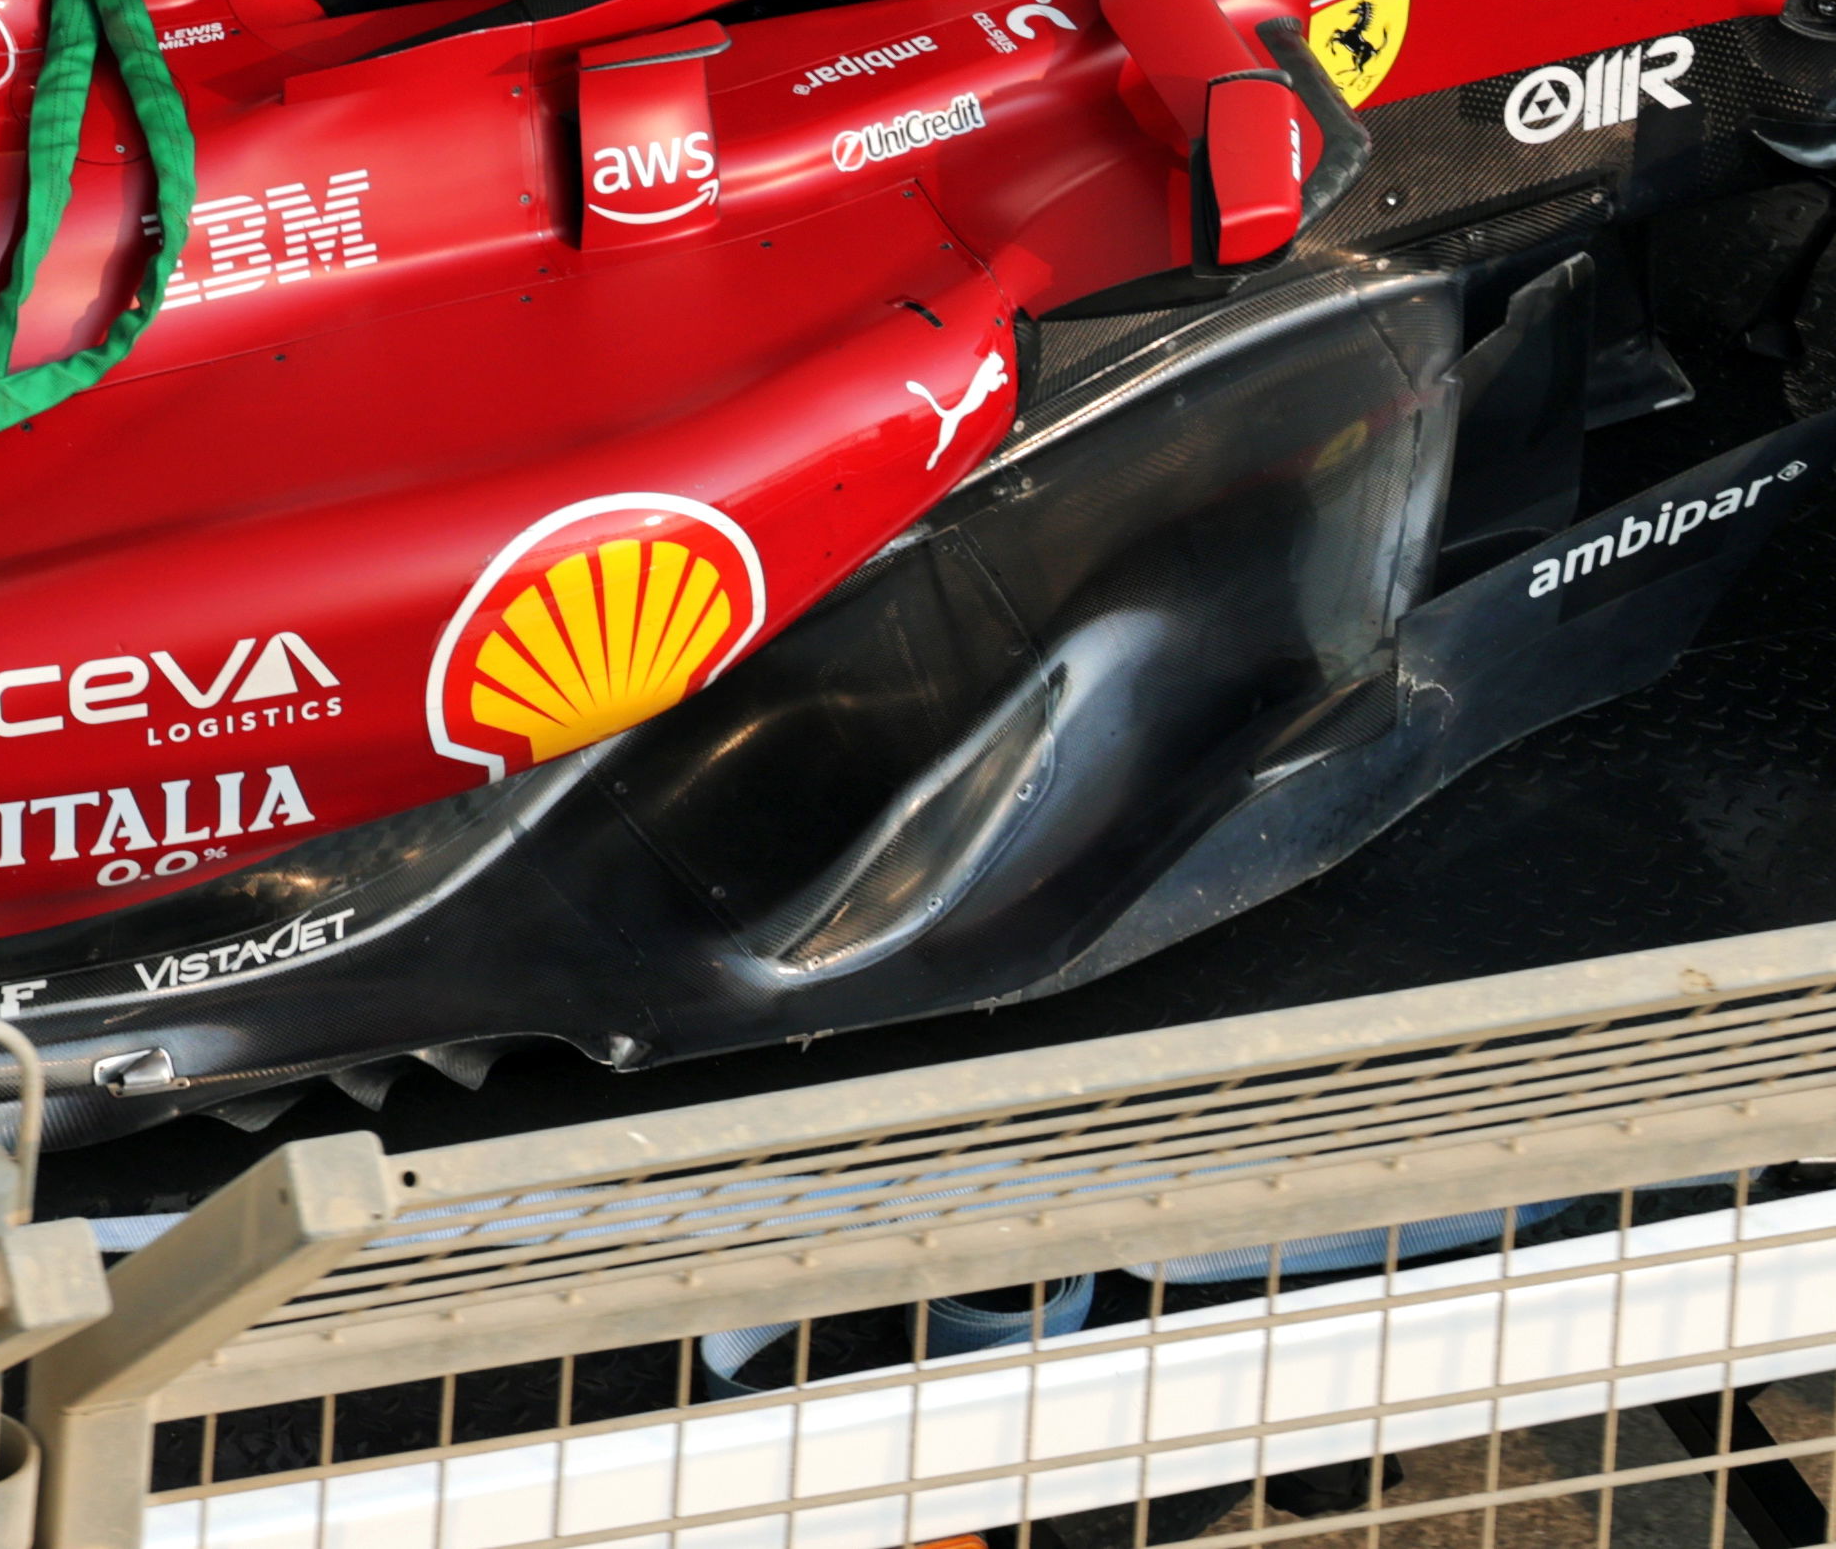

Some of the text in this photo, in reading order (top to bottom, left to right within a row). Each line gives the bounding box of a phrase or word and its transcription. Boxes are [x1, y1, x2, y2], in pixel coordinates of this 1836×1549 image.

[158, 31, 225, 50] MILTON
[164, 22, 222, 41] LEWIS
[972, 12, 1018, 54] CELSIUS
[866, 97, 980, 158] UniCredit
[592, 130, 715, 194] aws
[147, 697, 343, 746] LOGISTICS
[96, 846, 228, 887] 0.0%
[134, 909, 355, 994] VISTAJET
